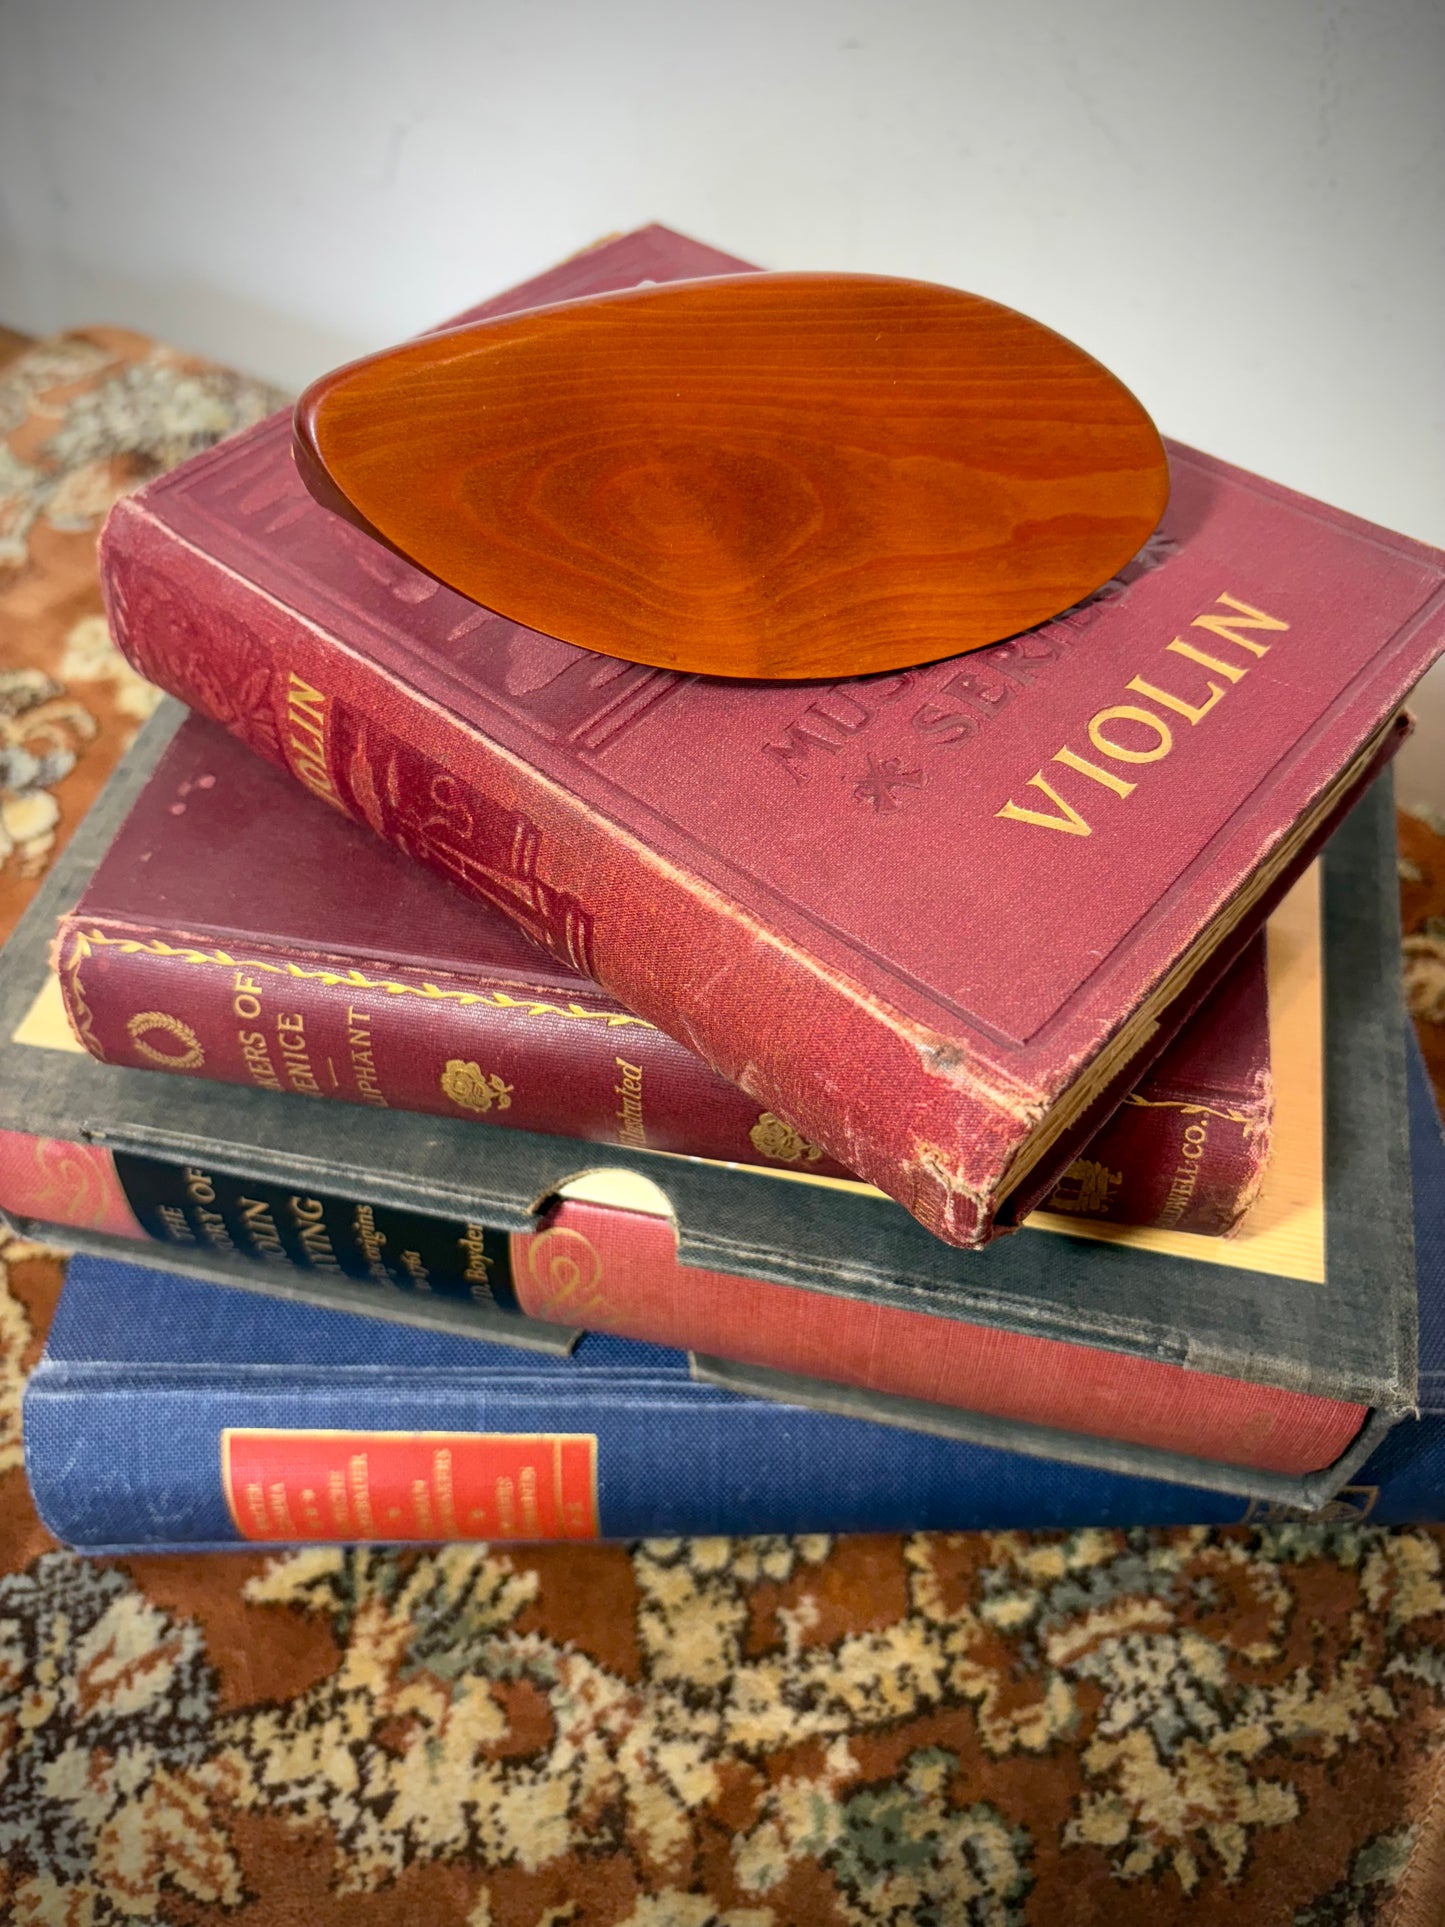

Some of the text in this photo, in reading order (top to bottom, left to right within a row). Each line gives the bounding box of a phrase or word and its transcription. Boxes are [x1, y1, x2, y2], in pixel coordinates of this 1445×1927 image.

[993, 591, 1291, 837] VIOLIN
[232, 971, 286, 1093] KERS OF
[347, 1004, 389, 1108] LIPHANT
[157, 1204, 197, 1241] THE
[184, 1166, 216, 1204] OF
